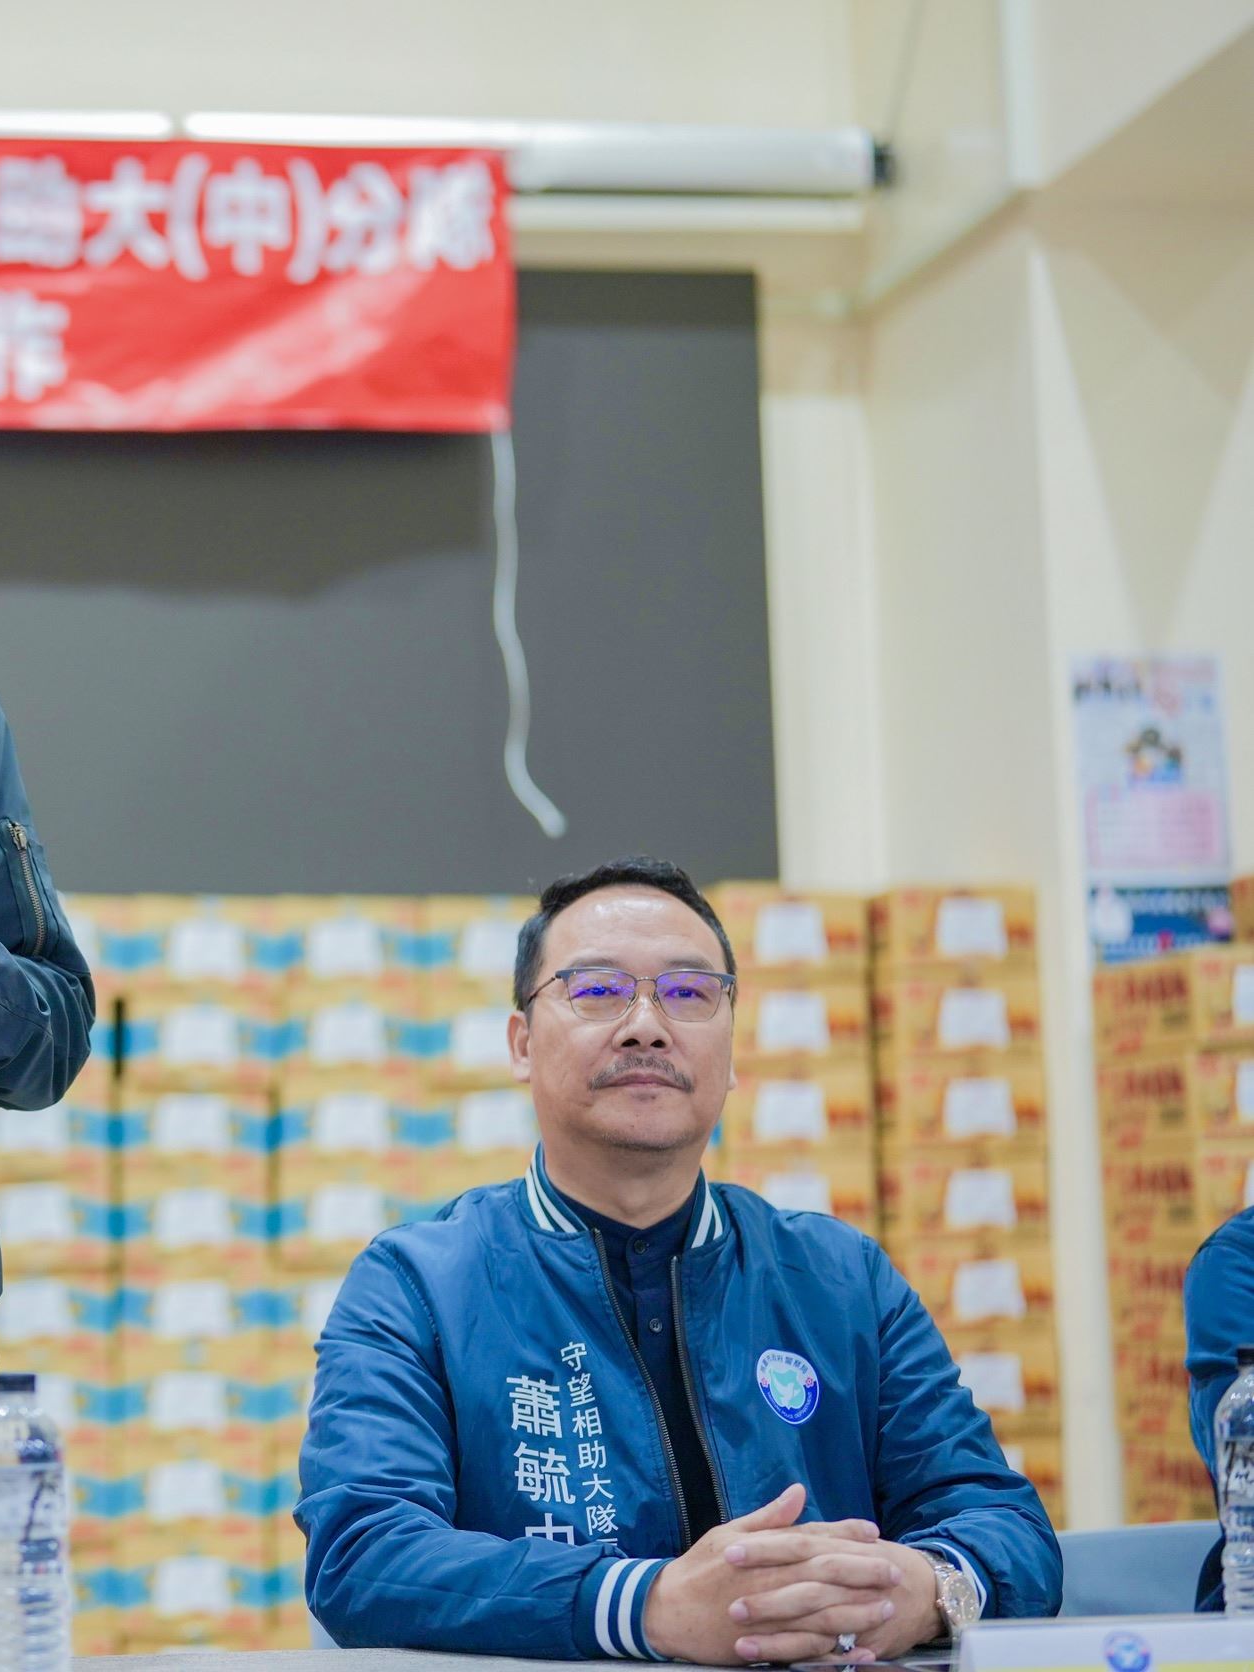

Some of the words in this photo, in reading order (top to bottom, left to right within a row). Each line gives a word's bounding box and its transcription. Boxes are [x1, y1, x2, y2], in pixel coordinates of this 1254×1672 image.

[560, 1341, 619, 1547] 守望相助大隊
